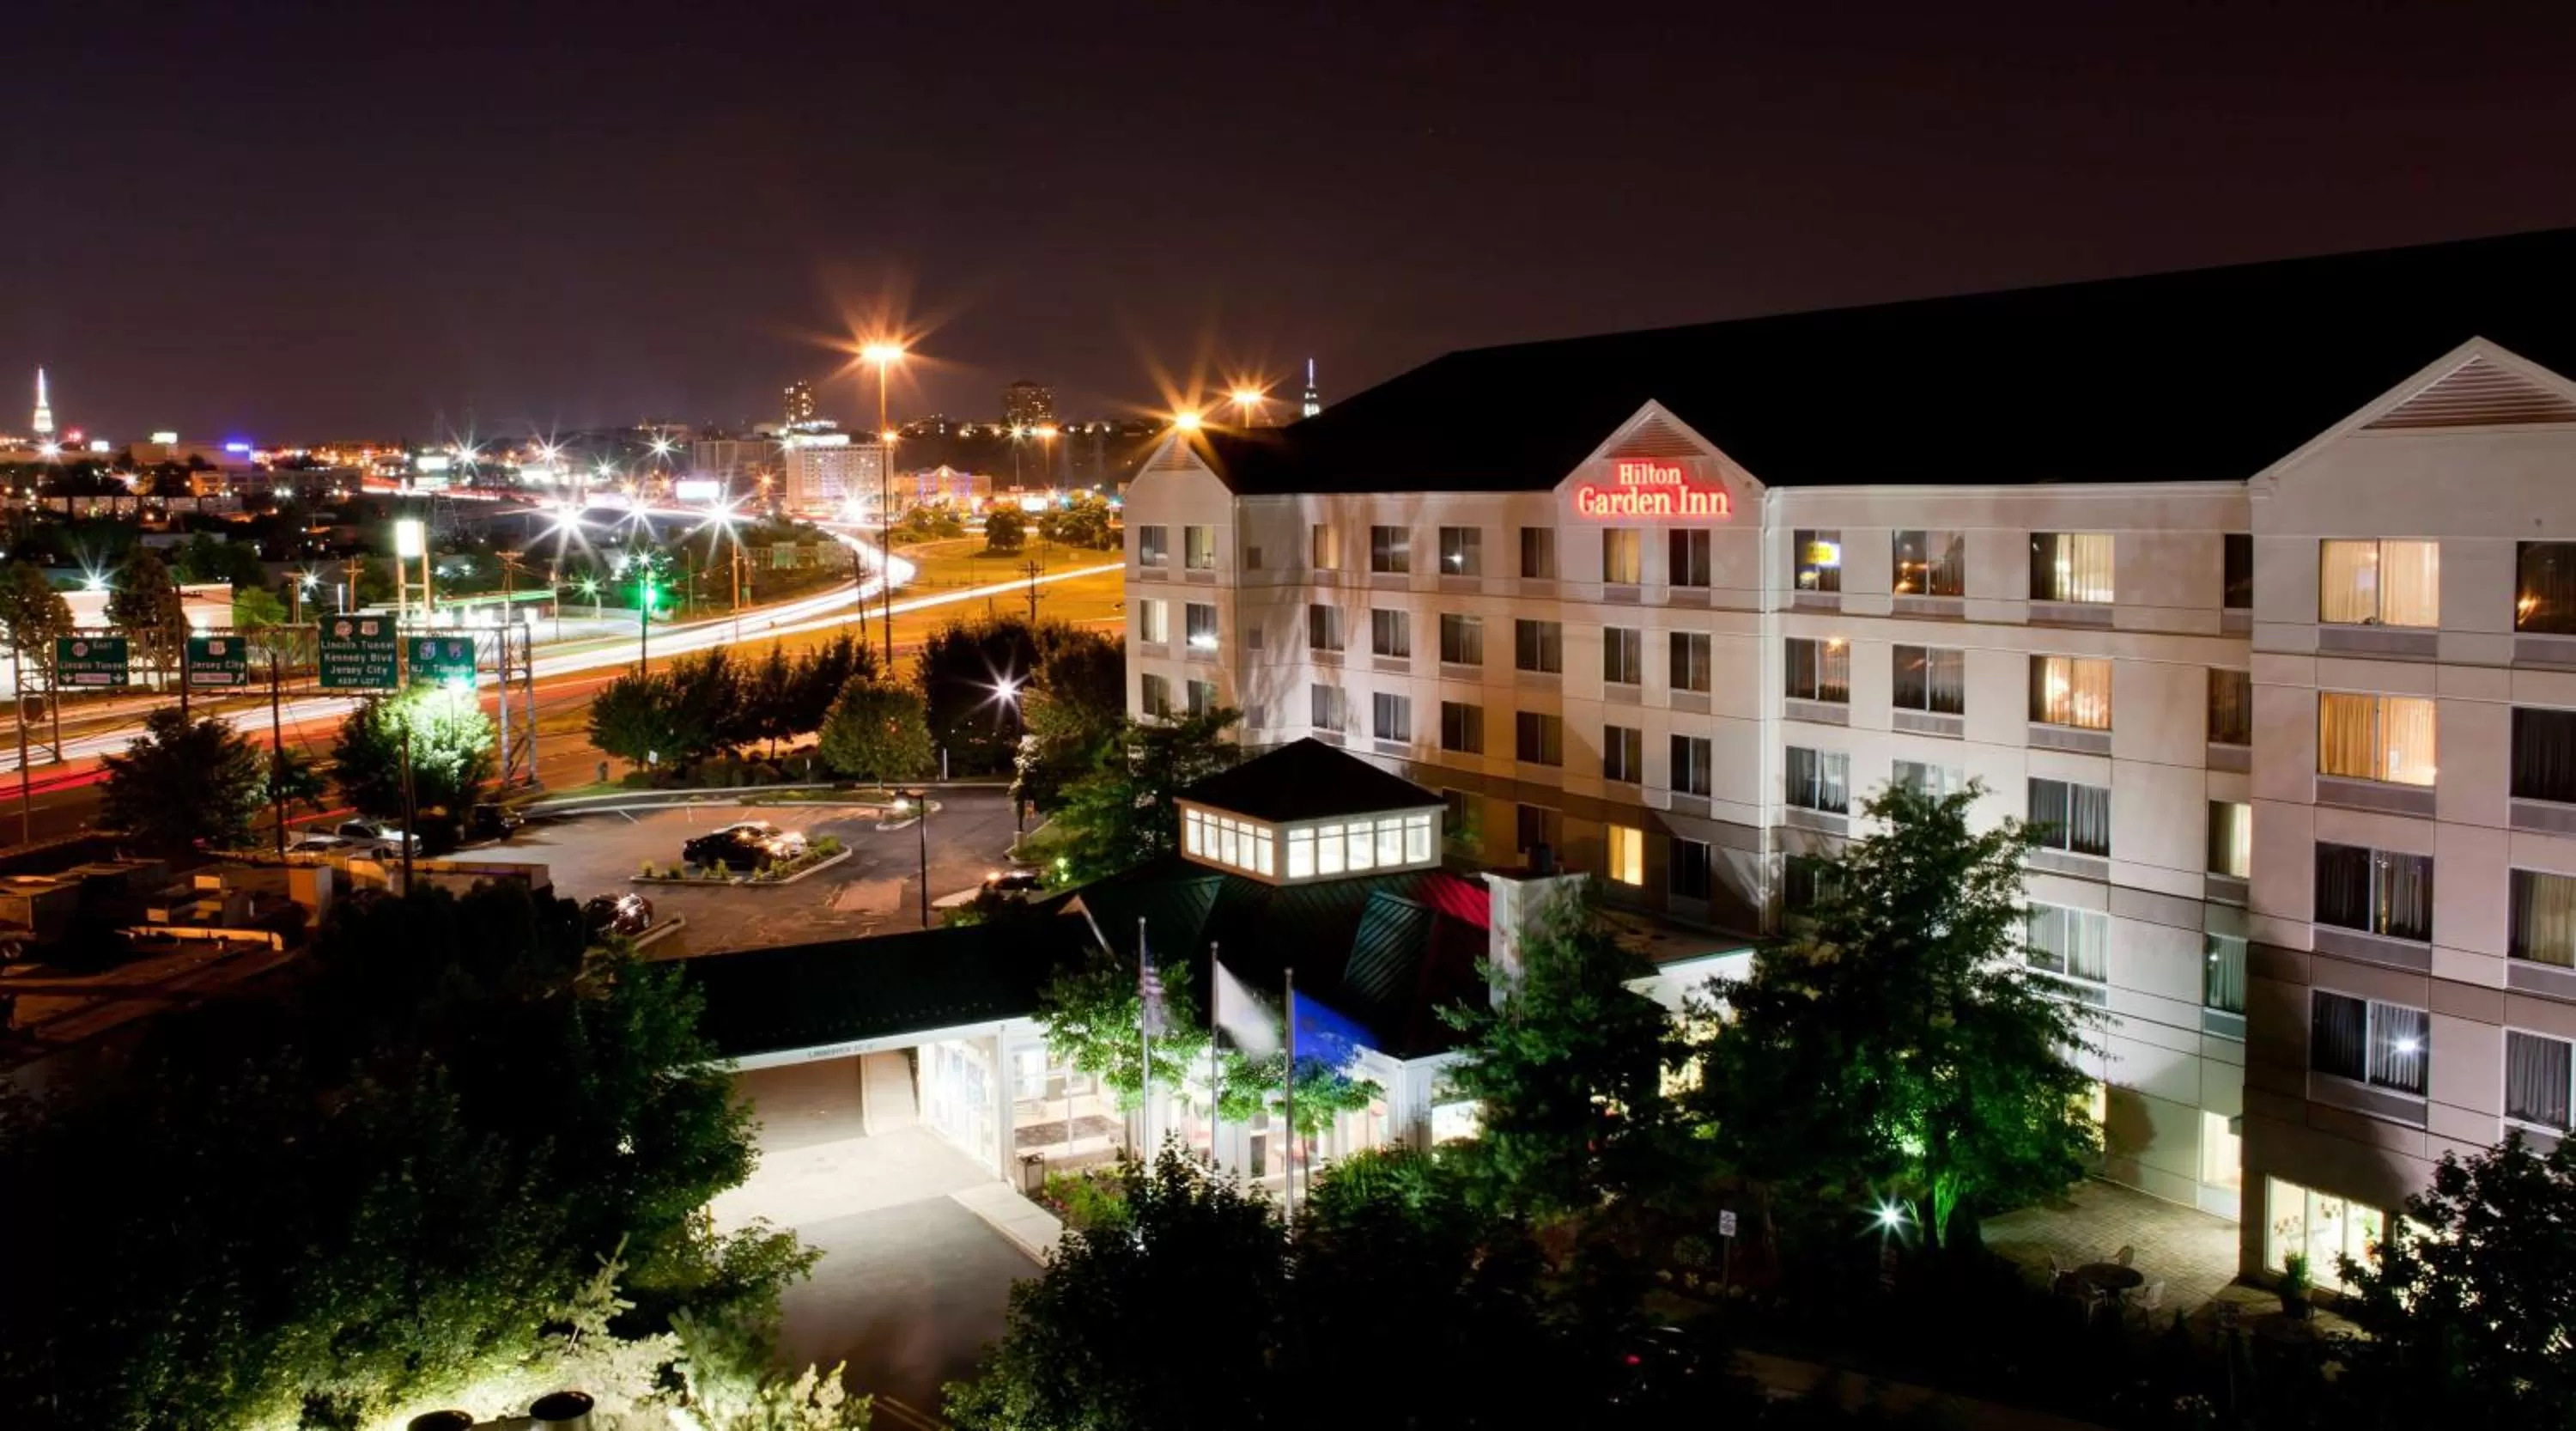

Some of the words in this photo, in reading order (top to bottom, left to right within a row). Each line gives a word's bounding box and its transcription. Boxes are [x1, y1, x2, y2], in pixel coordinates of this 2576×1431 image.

[1619, 463, 1682, 485] Hilton
[1578, 486, 1672, 515] Garden
[1678, 485, 1729, 515] Inn
[320, 639, 357, 649] Lincoln
[361, 640, 395, 649] Tunnel
[324, 653, 365, 663] Kennedy
[370, 653, 392, 662] Blvd
[58, 661, 92, 670] Lincoln
[95, 661, 126, 670] Tunnel
[191, 661, 221, 670] Jersey
[225, 660, 245, 670] City
[410, 664, 423, 673] NJ
[329, 665, 361, 675] Jersey
[367, 665, 388, 676] City
